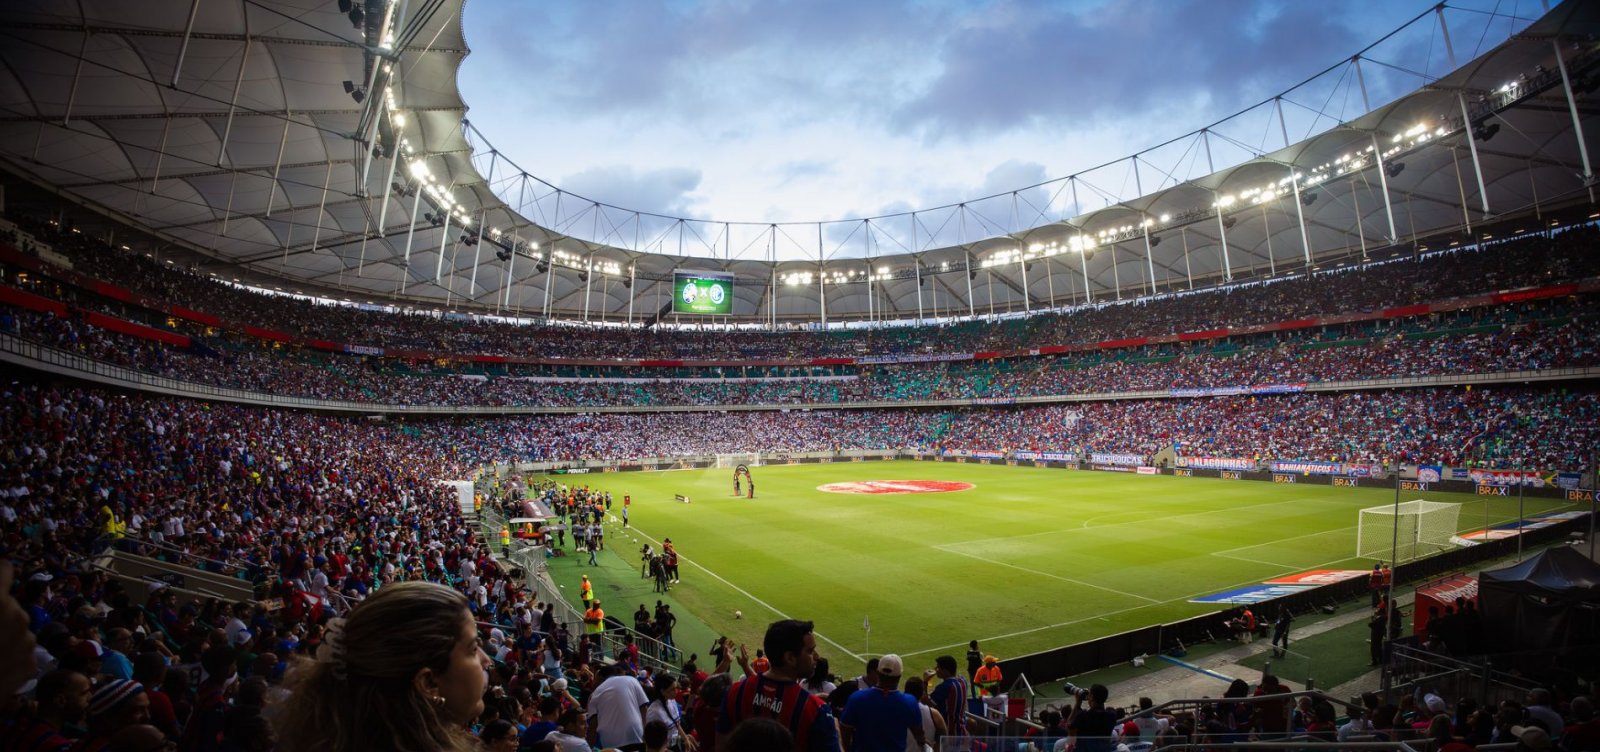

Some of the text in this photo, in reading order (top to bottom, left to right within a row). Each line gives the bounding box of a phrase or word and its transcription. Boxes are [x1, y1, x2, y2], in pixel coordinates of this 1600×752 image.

[1194, 458, 1248, 469] ALAGOINHAS
[1175, 469, 1191, 477] BRAX
[1222, 472, 1239, 480] BRAX
[1274, 475, 1294, 483] BRAX
[1334, 478, 1356, 487] BRAX
[1401, 482, 1425, 491] BRAX
[1478, 486, 1506, 496] BRAX
